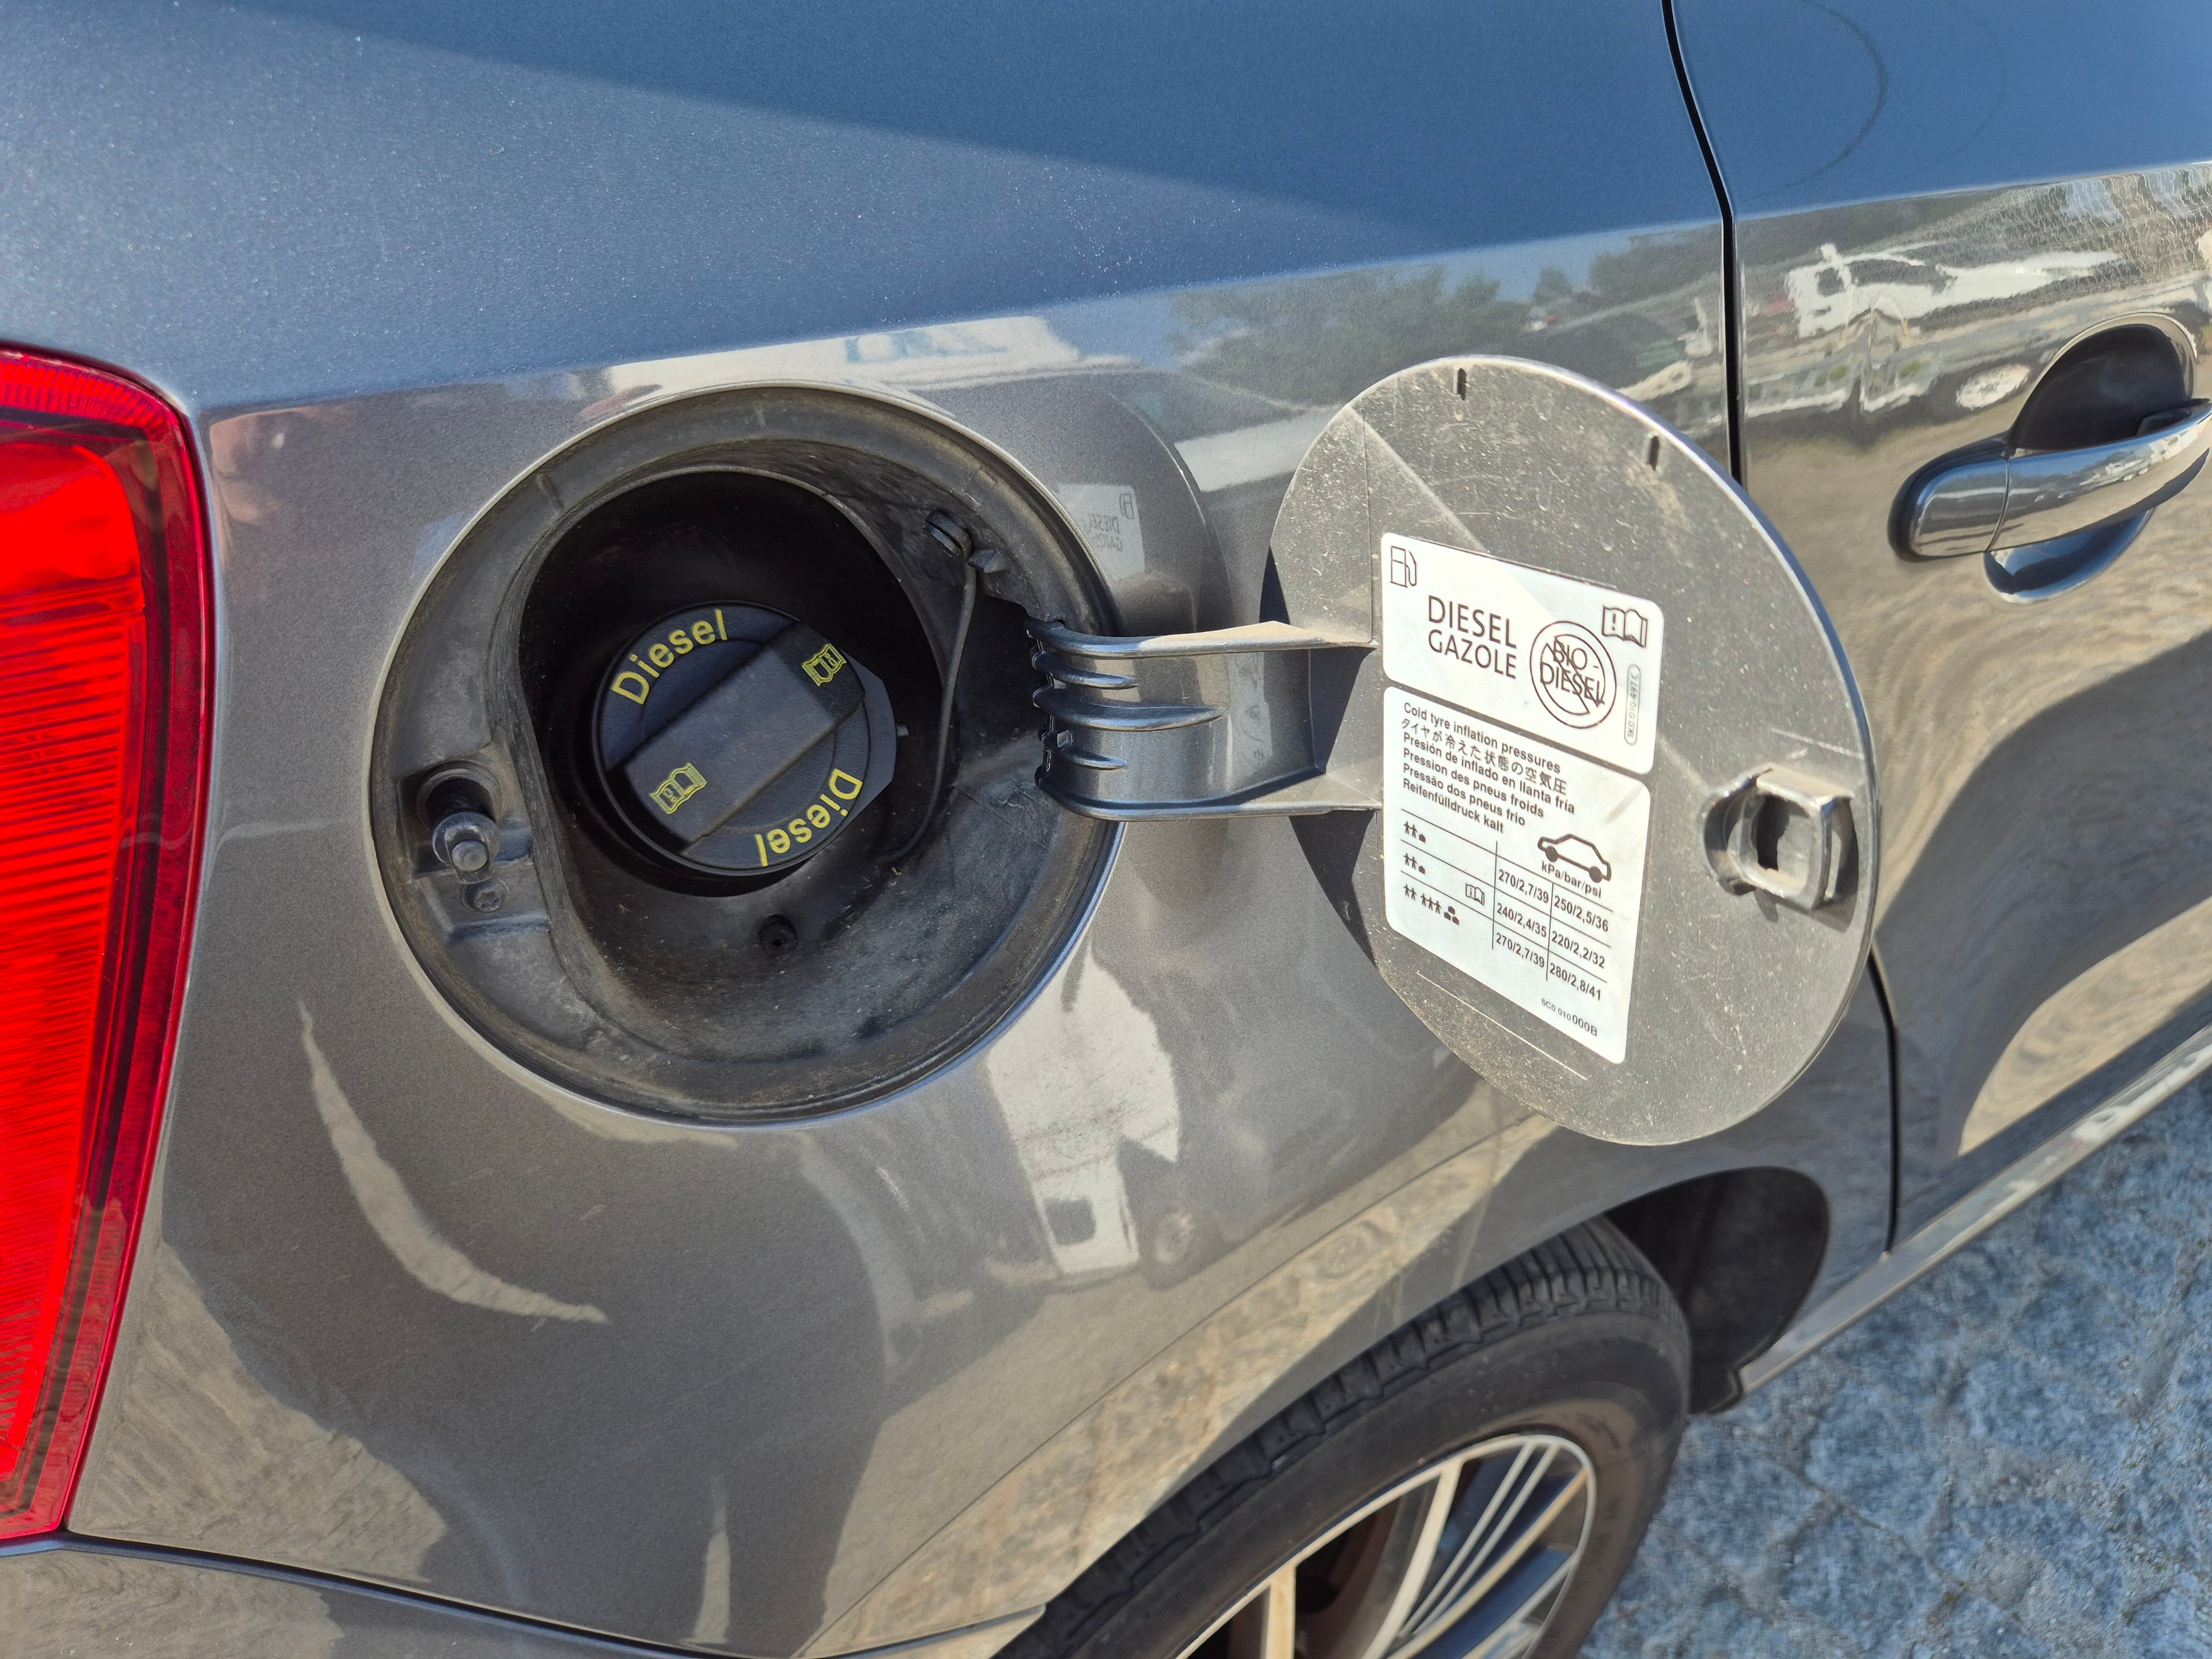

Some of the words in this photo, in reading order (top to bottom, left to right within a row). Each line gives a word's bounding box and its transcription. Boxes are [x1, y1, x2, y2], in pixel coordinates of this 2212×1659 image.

[1428, 594, 1517, 649] DIESEL
[611, 609, 728, 704] Diesel
[1428, 629, 1516, 679] GAZOLE
[1540, 661, 1605, 705] DIESEL
[1404, 702, 1427, 721] Cold
[1430, 713, 1450, 729] tyre
[1453, 721, 1498, 749] inflation
[1502, 743, 1560, 774] pressures
[1404, 732, 1442, 757] Presión
[1445, 751, 1458, 763] de
[1461, 756, 1498, 781] inflado
[1502, 776, 1516, 789] en
[1520, 780, 1551, 804] llanta
[1404, 747, 1448, 776] Pression
[1451, 770, 1469, 785] des
[1473, 779, 1507, 801] pneus
[1510, 794, 1544, 817] froids
[755, 768, 863, 867] Diesel
[1403, 763, 1444, 789] Pressão
[1447, 783, 1466, 800] dos
[1469, 794, 1502, 816] pneus
[1506, 809, 1525, 825] frio
[1403, 778, 1480, 823] Reifenfülldruck
[1484, 814, 1503, 834] kalt
[1498, 869, 1549, 904] 270/2,7/39
[1541, 861, 1601, 899] kPa/bar/psi
[1497, 903, 1547, 938] 240/2,4/35
[1554, 895, 1608, 932] 250/2,5/36
[1496, 932, 1544, 968] 270/2,7/39
[1551, 930, 1605, 969] 220/2,2/32
[1549, 963, 1601, 1001] 280/2,8/41
